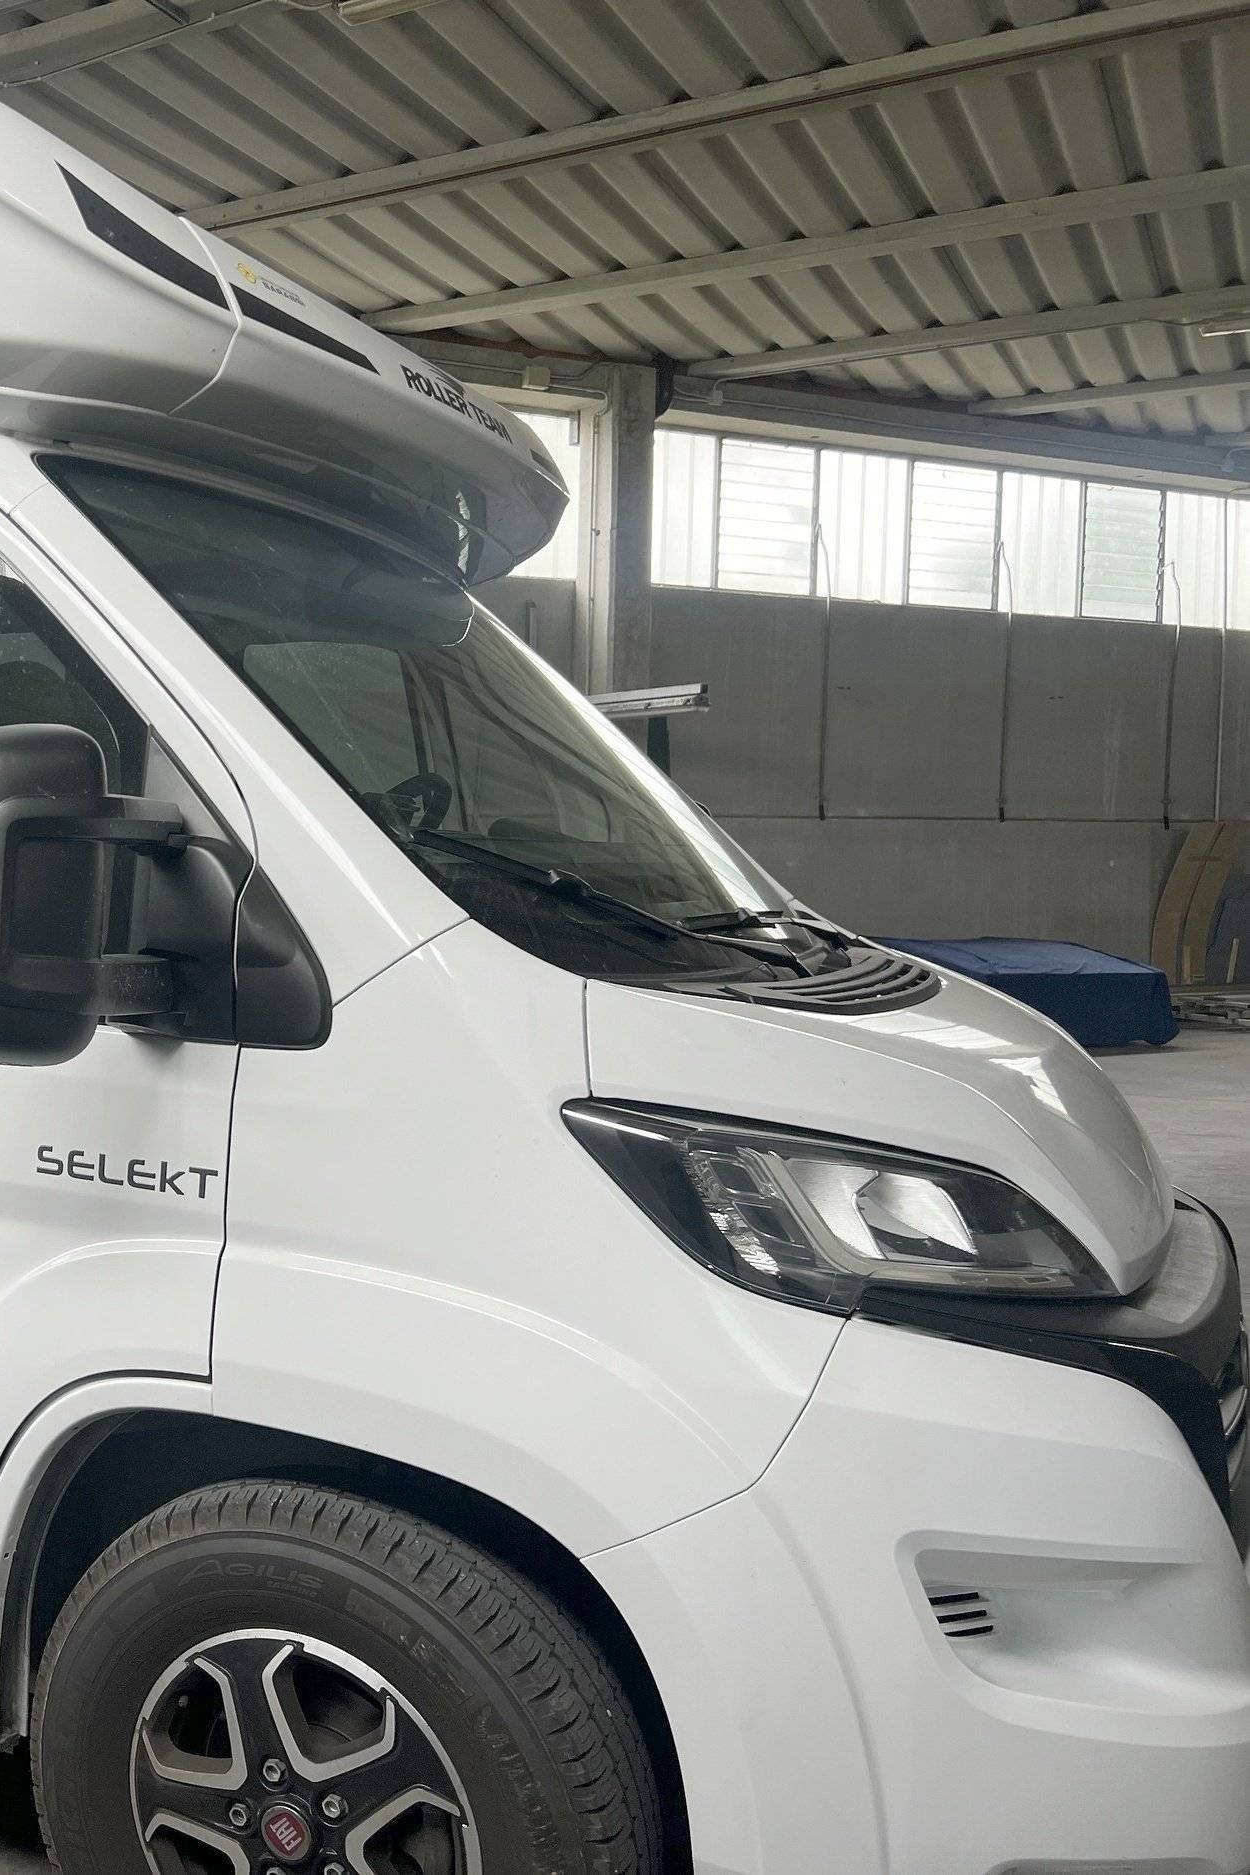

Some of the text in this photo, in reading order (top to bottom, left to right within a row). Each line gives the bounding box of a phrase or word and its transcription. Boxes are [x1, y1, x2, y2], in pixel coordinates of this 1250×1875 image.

[400, 364, 513, 445] ROLLER TEAM
[36, 1145, 219, 1199] SELEKT
[270, 1817, 302, 1852] FIAT
